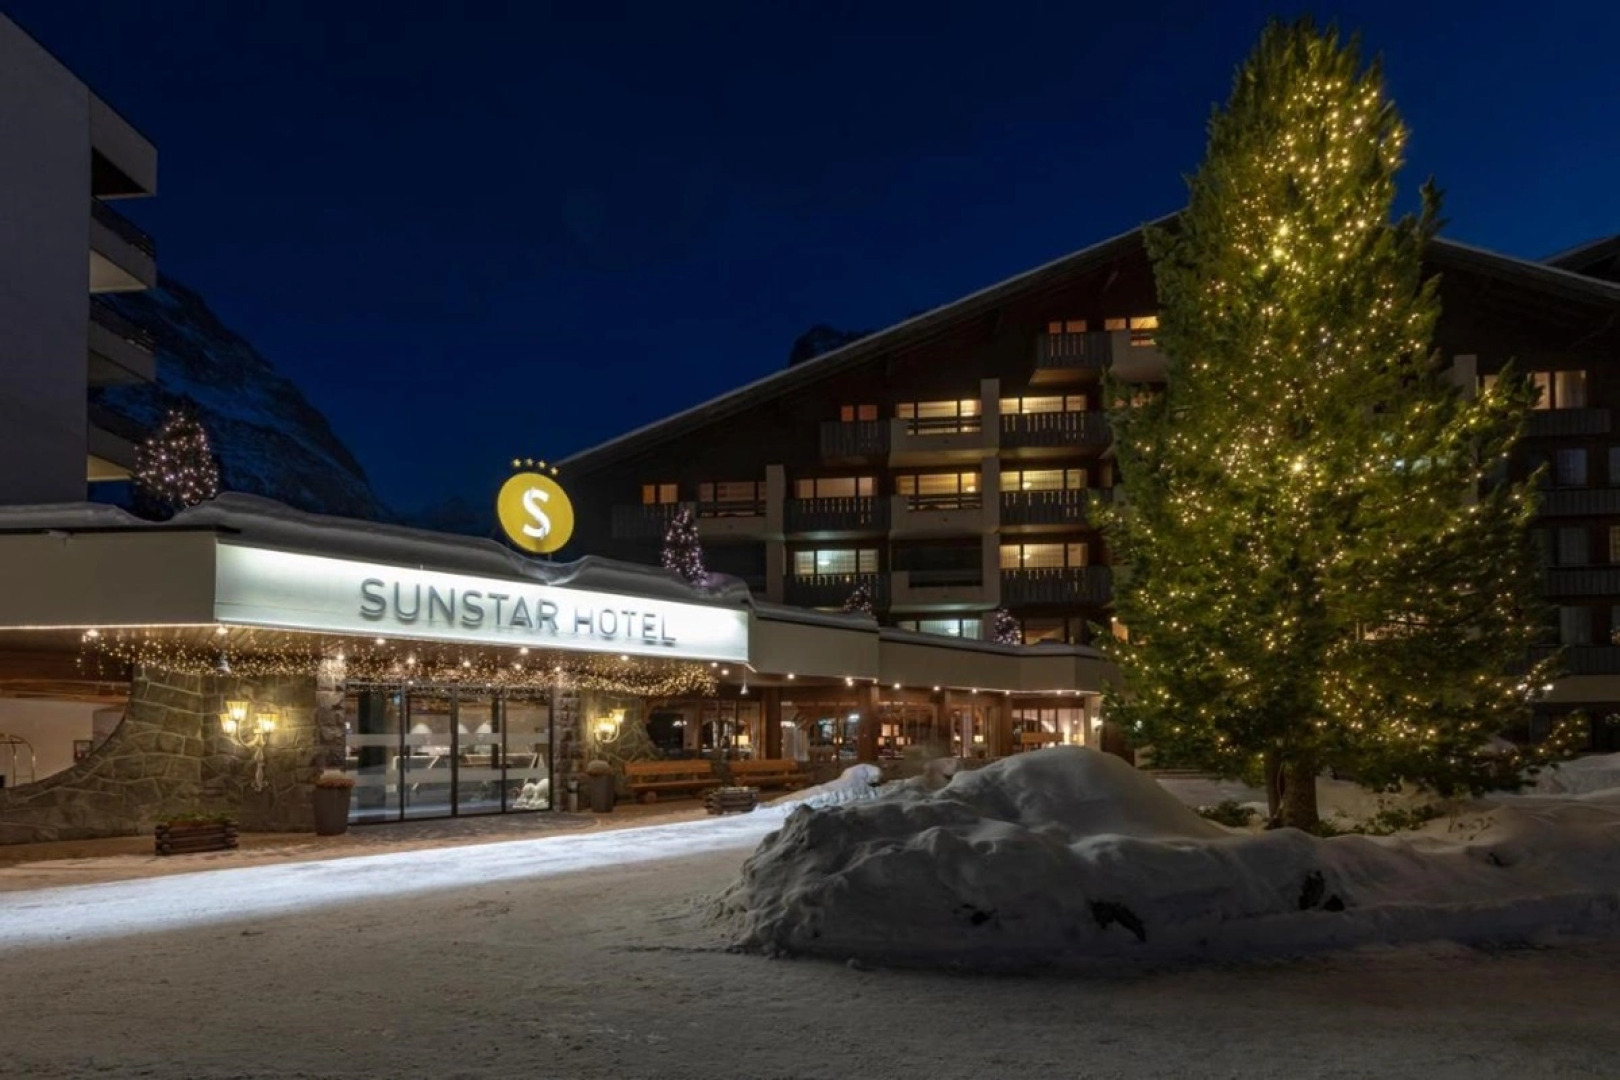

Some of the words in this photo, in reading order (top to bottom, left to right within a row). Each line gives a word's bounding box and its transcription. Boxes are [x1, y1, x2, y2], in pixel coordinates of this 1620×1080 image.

[522, 488, 550, 538] S
[360, 578, 559, 630] SUNSTAR
[574, 607, 677, 645] HOTEL
